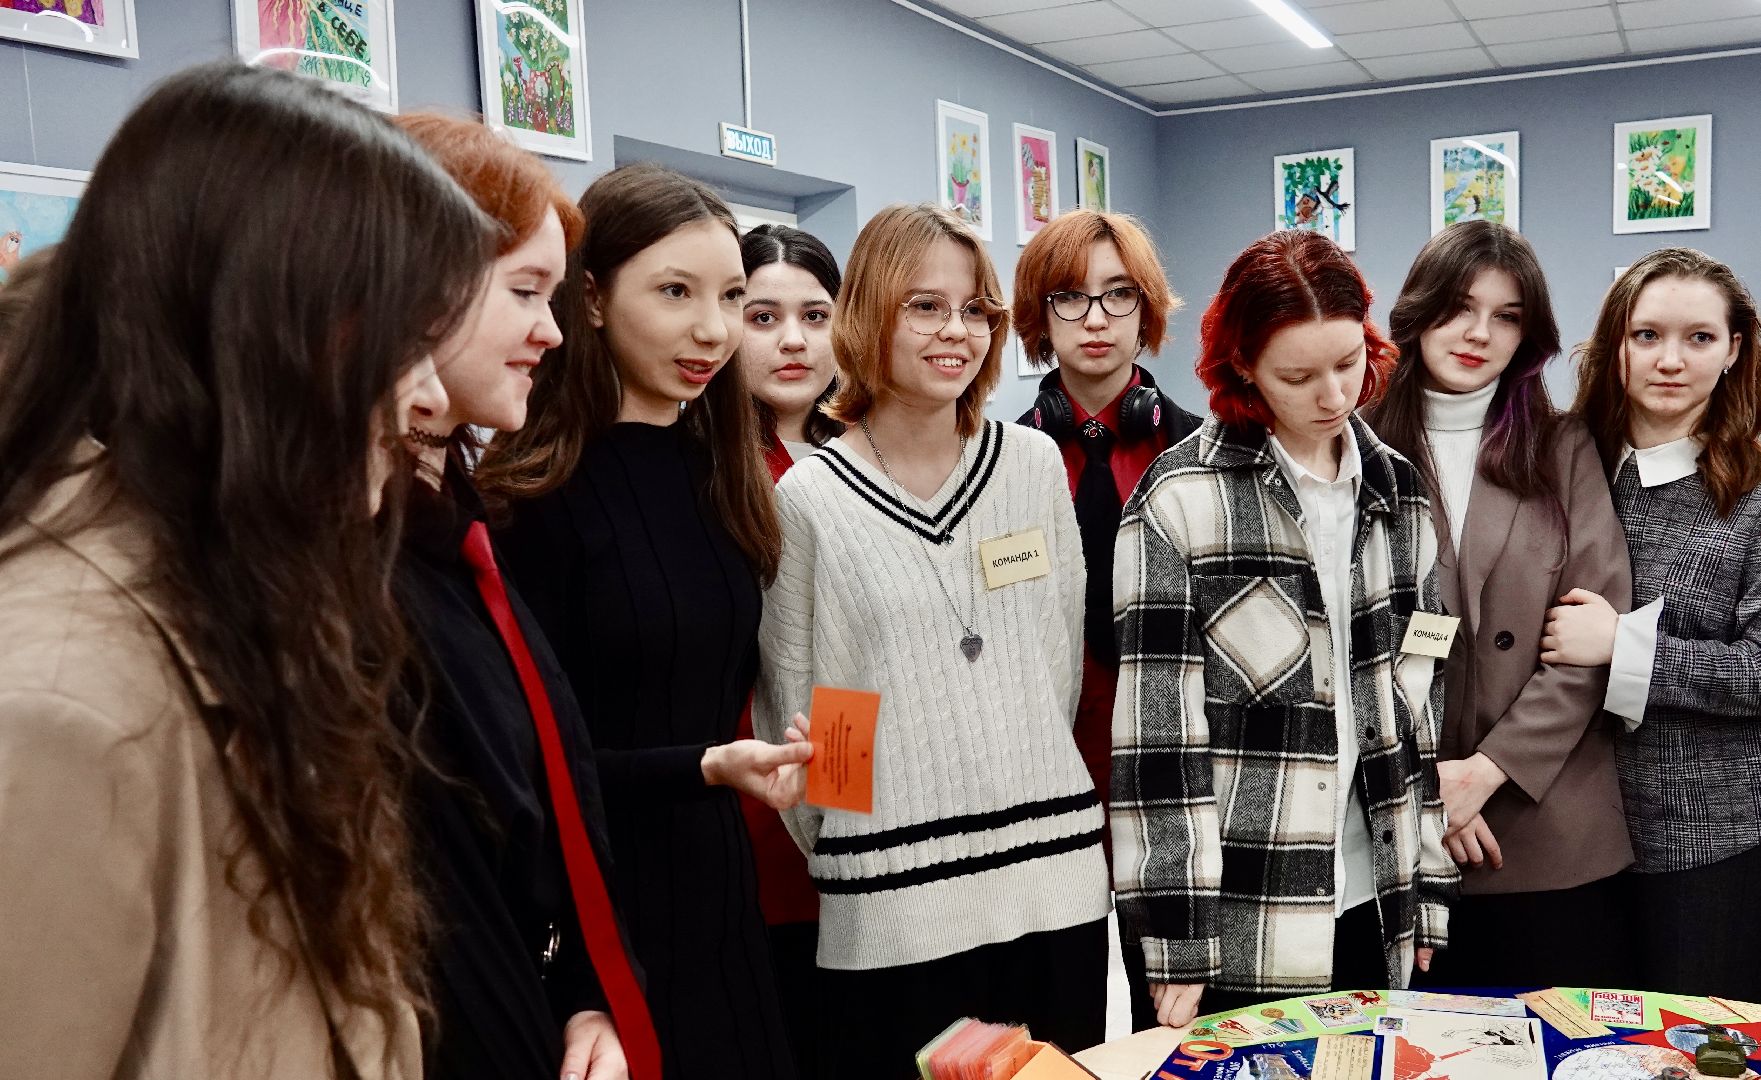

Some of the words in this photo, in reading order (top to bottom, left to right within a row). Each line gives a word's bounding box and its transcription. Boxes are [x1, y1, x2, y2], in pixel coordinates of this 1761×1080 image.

[331, 16, 368, 58] СЕБЕ
[727, 130, 771, 160] ВЫХОД
[992, 551, 1033, 568] КОМАНДА
[1033, 549, 1040, 558] 1
[1413, 630, 1443, 641] КОМАНДА
